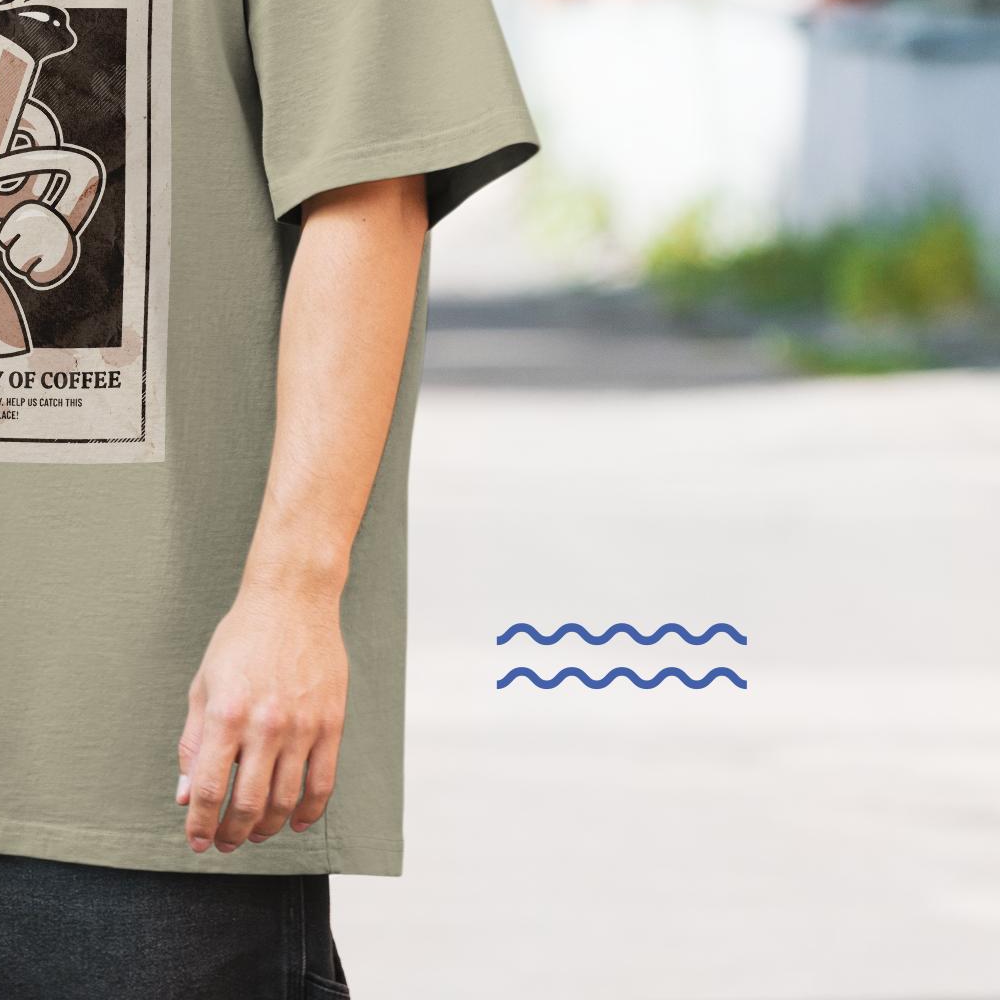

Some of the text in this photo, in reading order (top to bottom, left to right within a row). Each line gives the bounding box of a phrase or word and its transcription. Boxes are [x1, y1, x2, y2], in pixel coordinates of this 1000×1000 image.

[8, 370, 37, 389] OF
[40, 370, 122, 389] COFFEE
[6, 397, 26, 407] HELP
[27, 397, 38, 407] US
[39, 397, 63, 407] CATCH
[65, 398, 83, 408] THIS
